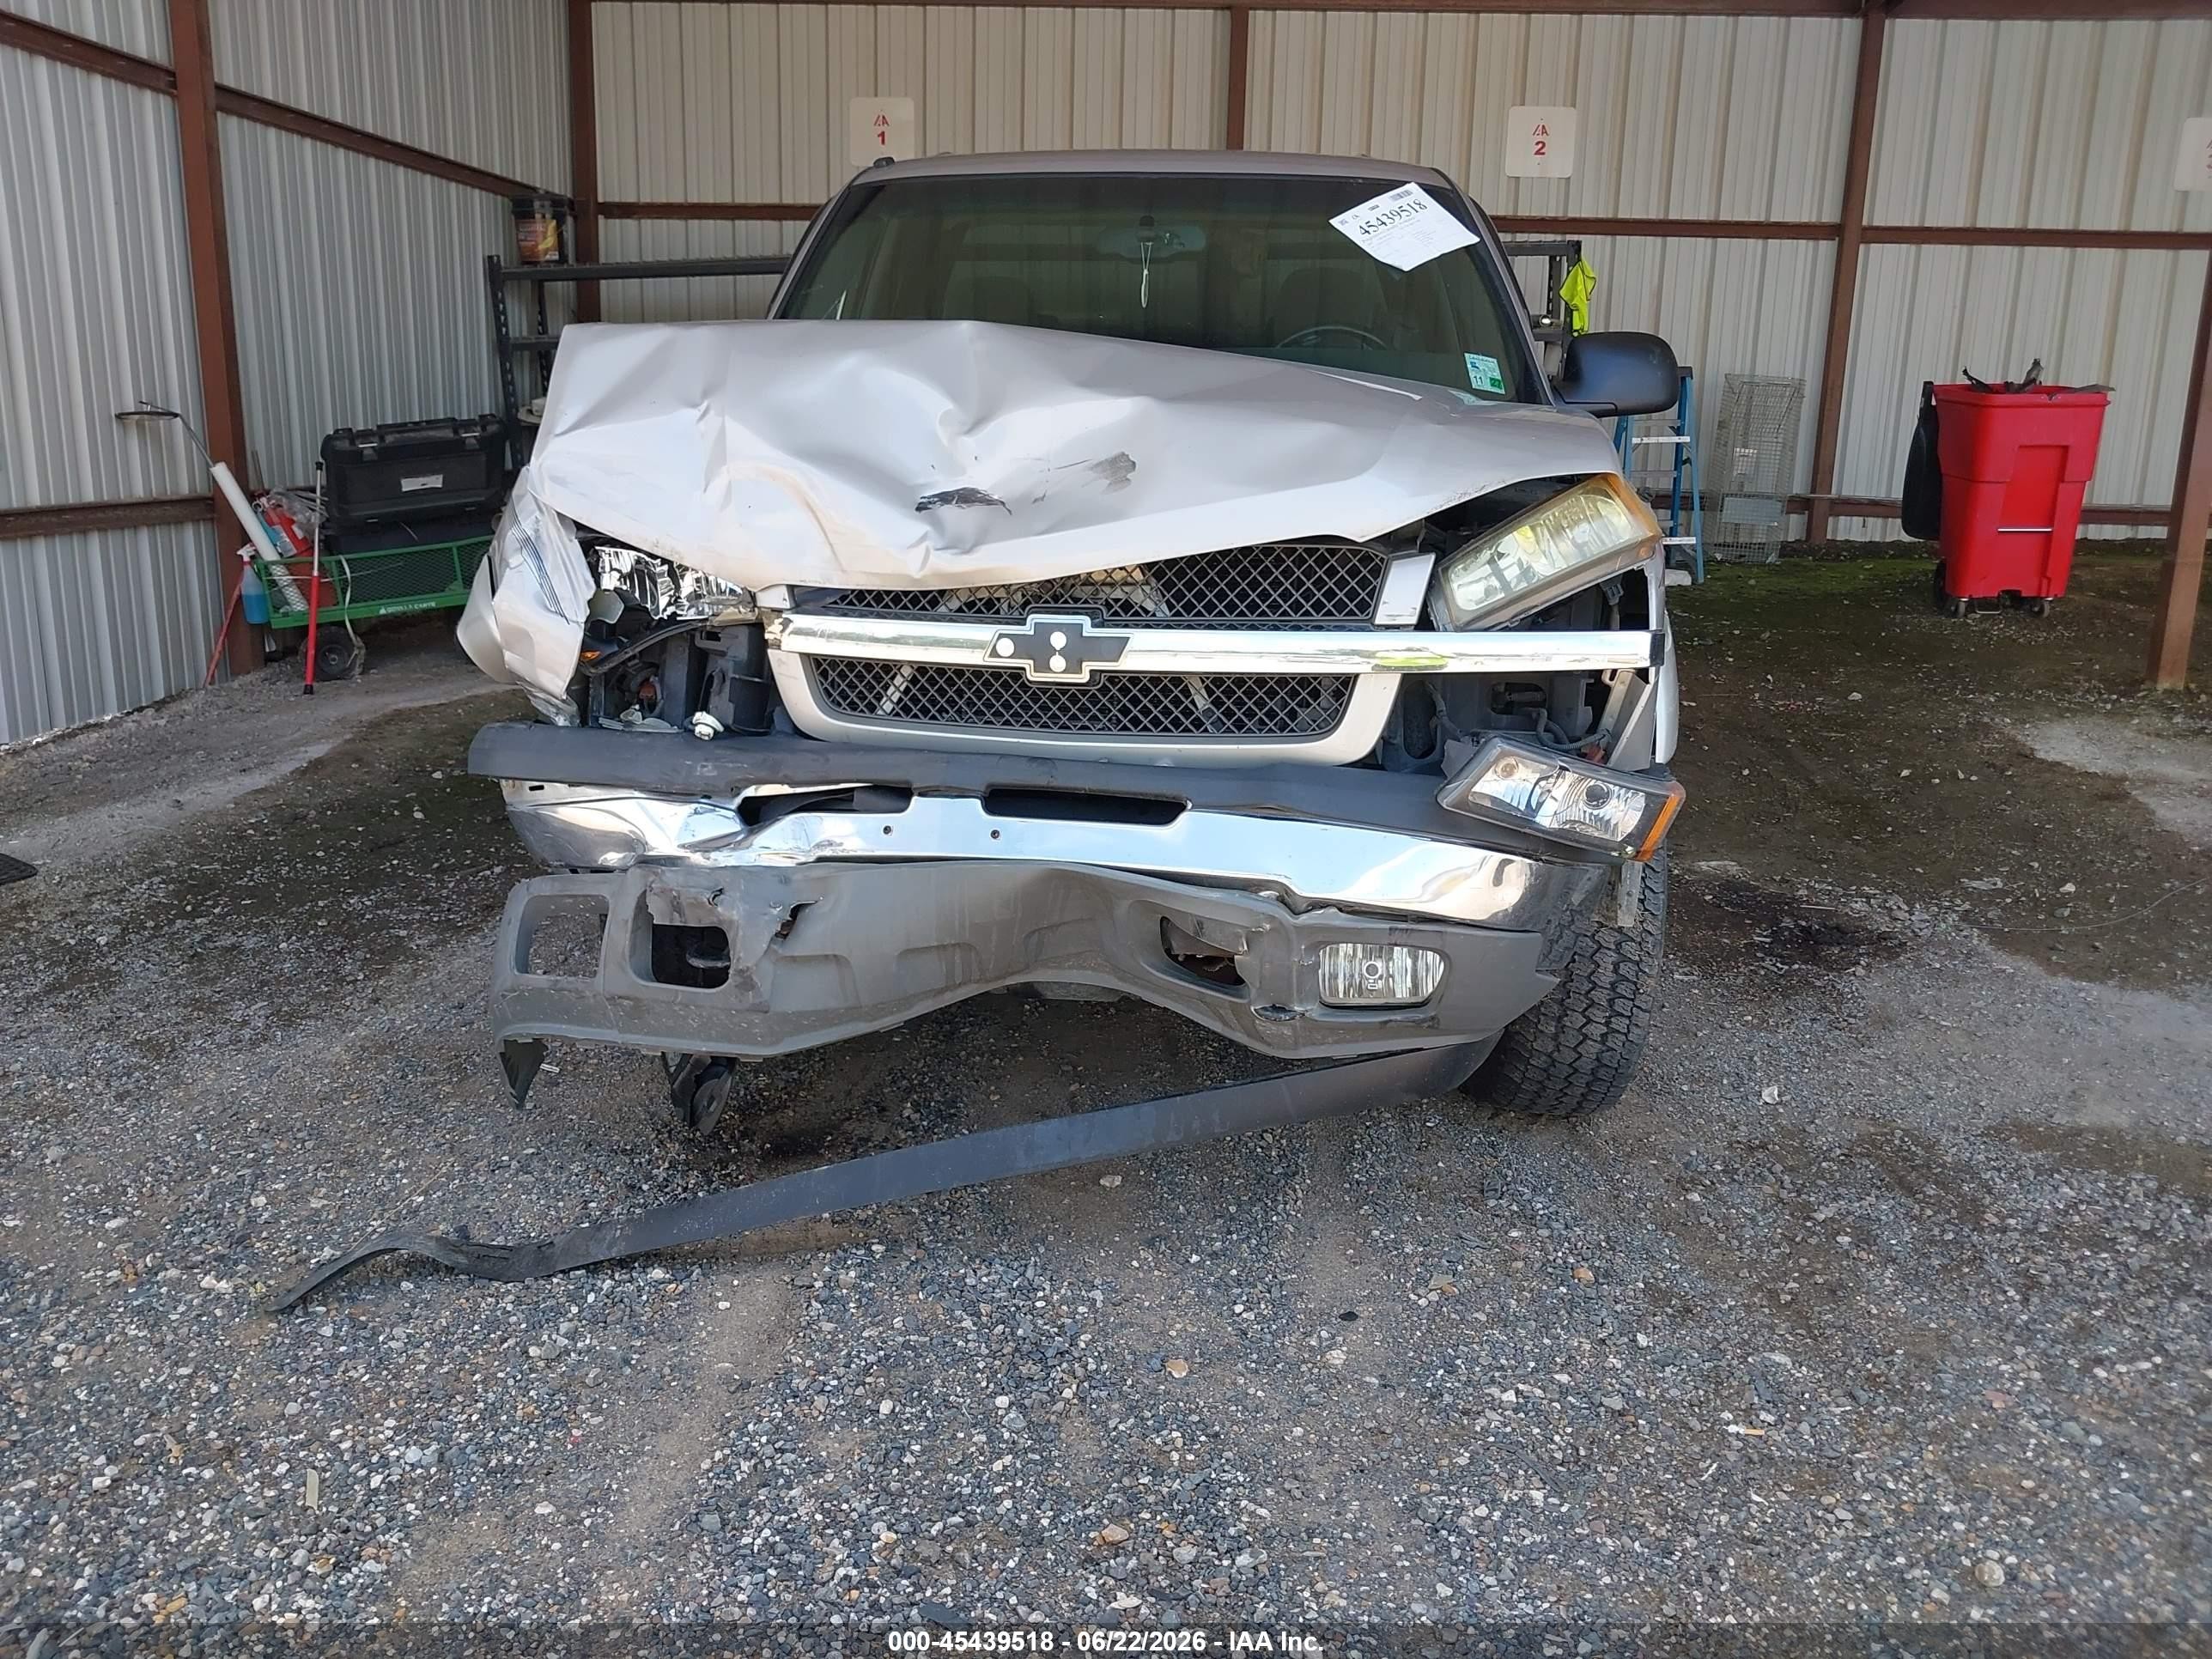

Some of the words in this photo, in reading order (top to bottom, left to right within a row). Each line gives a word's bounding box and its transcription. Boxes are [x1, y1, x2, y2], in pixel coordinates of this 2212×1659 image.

[878, 131, 885, 145] 1
[1534, 141, 1547, 155] 2
[1358, 198, 1427, 236] 45439518
[1473, 375, 1483, 385] 11
